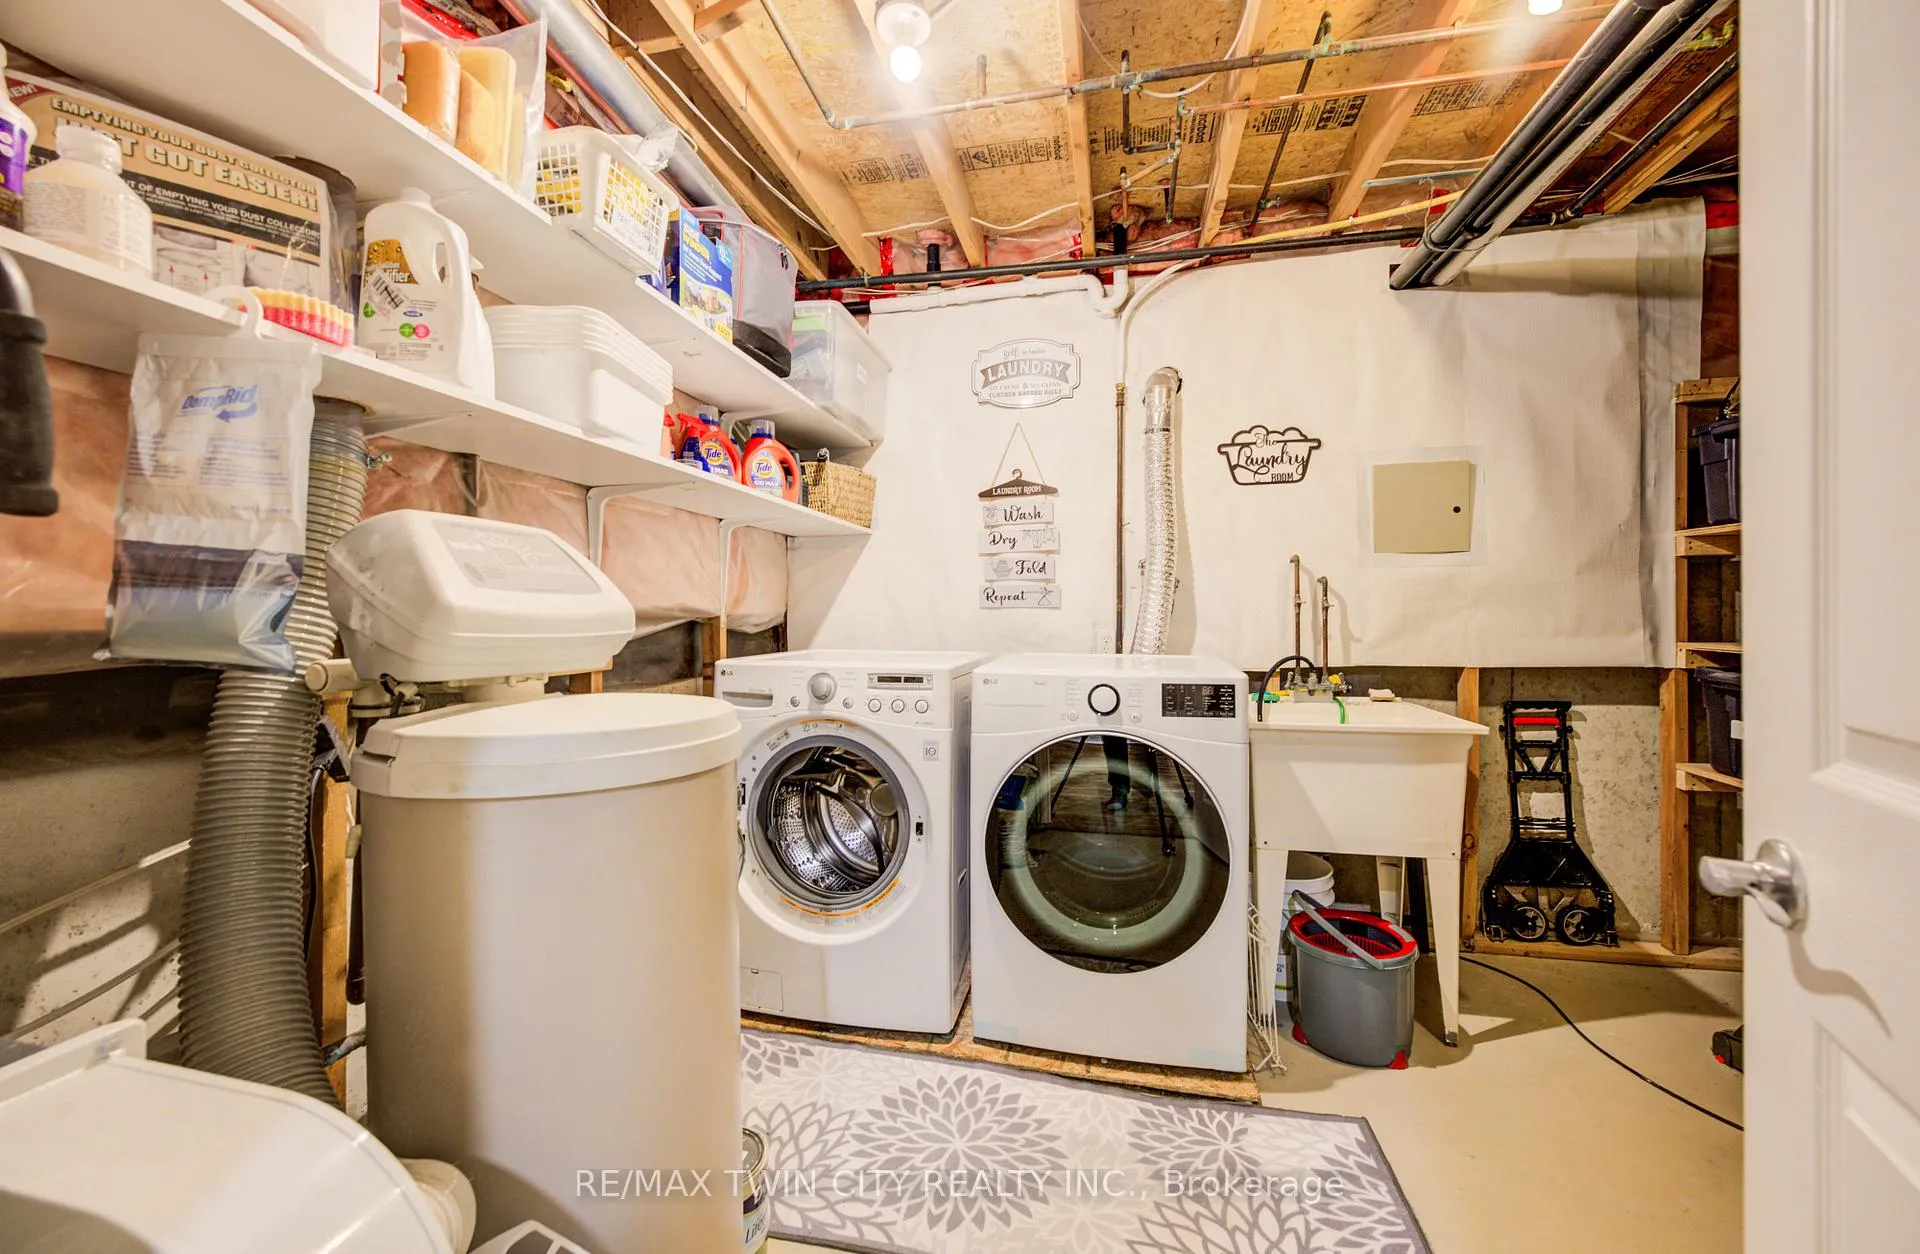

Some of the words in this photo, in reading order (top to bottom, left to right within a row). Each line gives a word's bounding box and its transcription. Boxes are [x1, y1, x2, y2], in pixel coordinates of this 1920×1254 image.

[51, 97, 145, 136] EMPTYING
[145, 126, 193, 151] YOUR
[194, 143, 238, 165] DUST
[239, 159, 317, 196] COLLECTOR
[144, 143, 209, 177] GOT
[213, 164, 319, 212] EASIER!
[138, 182, 154, 194] OF
[155, 186, 210, 209] EMPTYING
[211, 201, 240, 217] YOUR
[239, 209, 266, 224] DUST
[986, 359, 1065, 382] LAUNDRY
[181, 384, 259, 412] DampRid
[1255, 432, 1278, 448] The
[704, 447, 722, 460] Tide
[1232, 442, 1307, 476] Laundry
[755, 462, 773, 473] Tide
[1270, 472, 1294, 482] ROOM
[992, 486, 1023, 496] LAUNDRY
[1023, 485, 1041, 495] ROOM
[1003, 505, 1043, 522] Wash
[988, 530, 1018, 550] Dry
[1015, 559, 1047, 576] Fold
[983, 586, 1026, 606] Repeat
